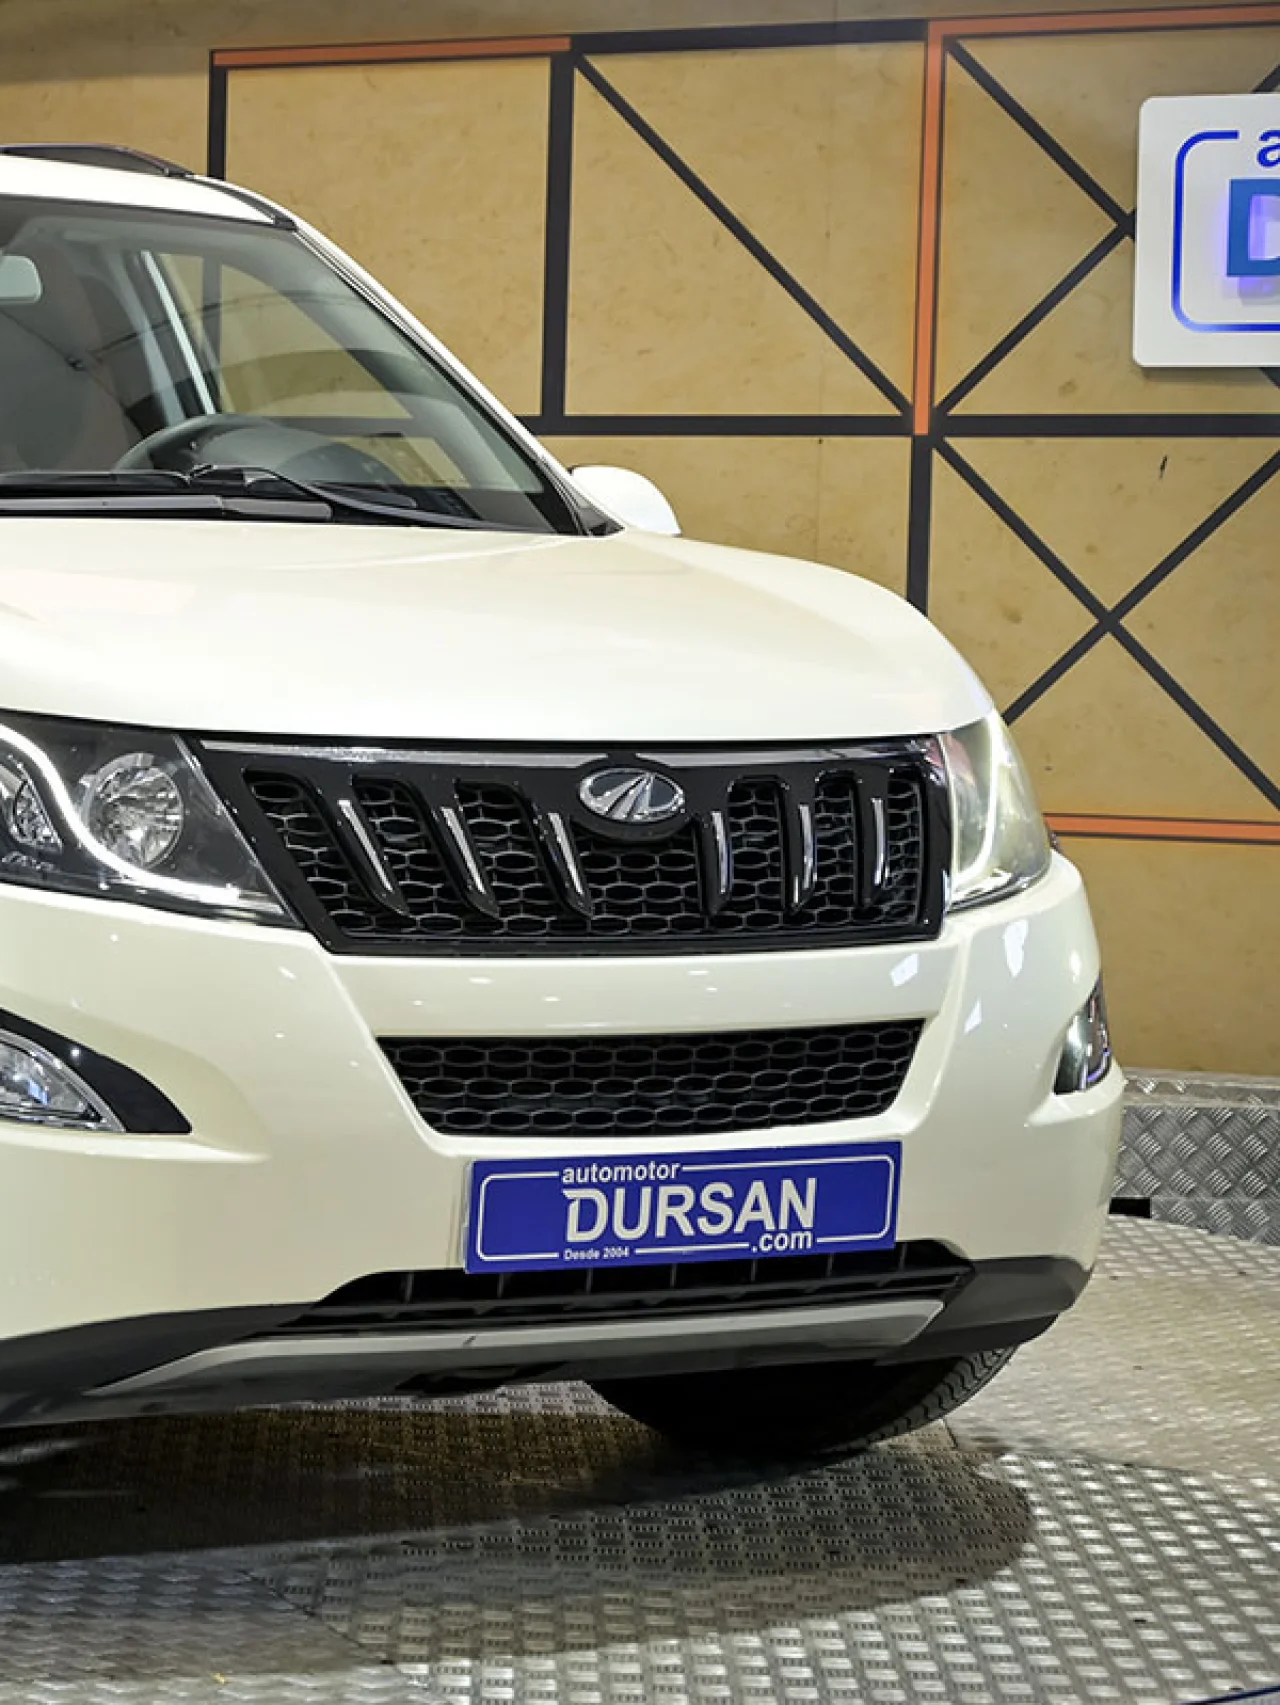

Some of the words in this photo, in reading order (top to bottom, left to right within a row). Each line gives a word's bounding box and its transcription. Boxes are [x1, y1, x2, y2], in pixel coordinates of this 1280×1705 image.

[562, 1161, 680, 1183] automotor
[562, 1177, 817, 1243] DURSAN
[751, 1231, 812, 1253] .com
[563, 1248, 599, 1261] Desde
[603, 1246, 629, 1259] 2004
